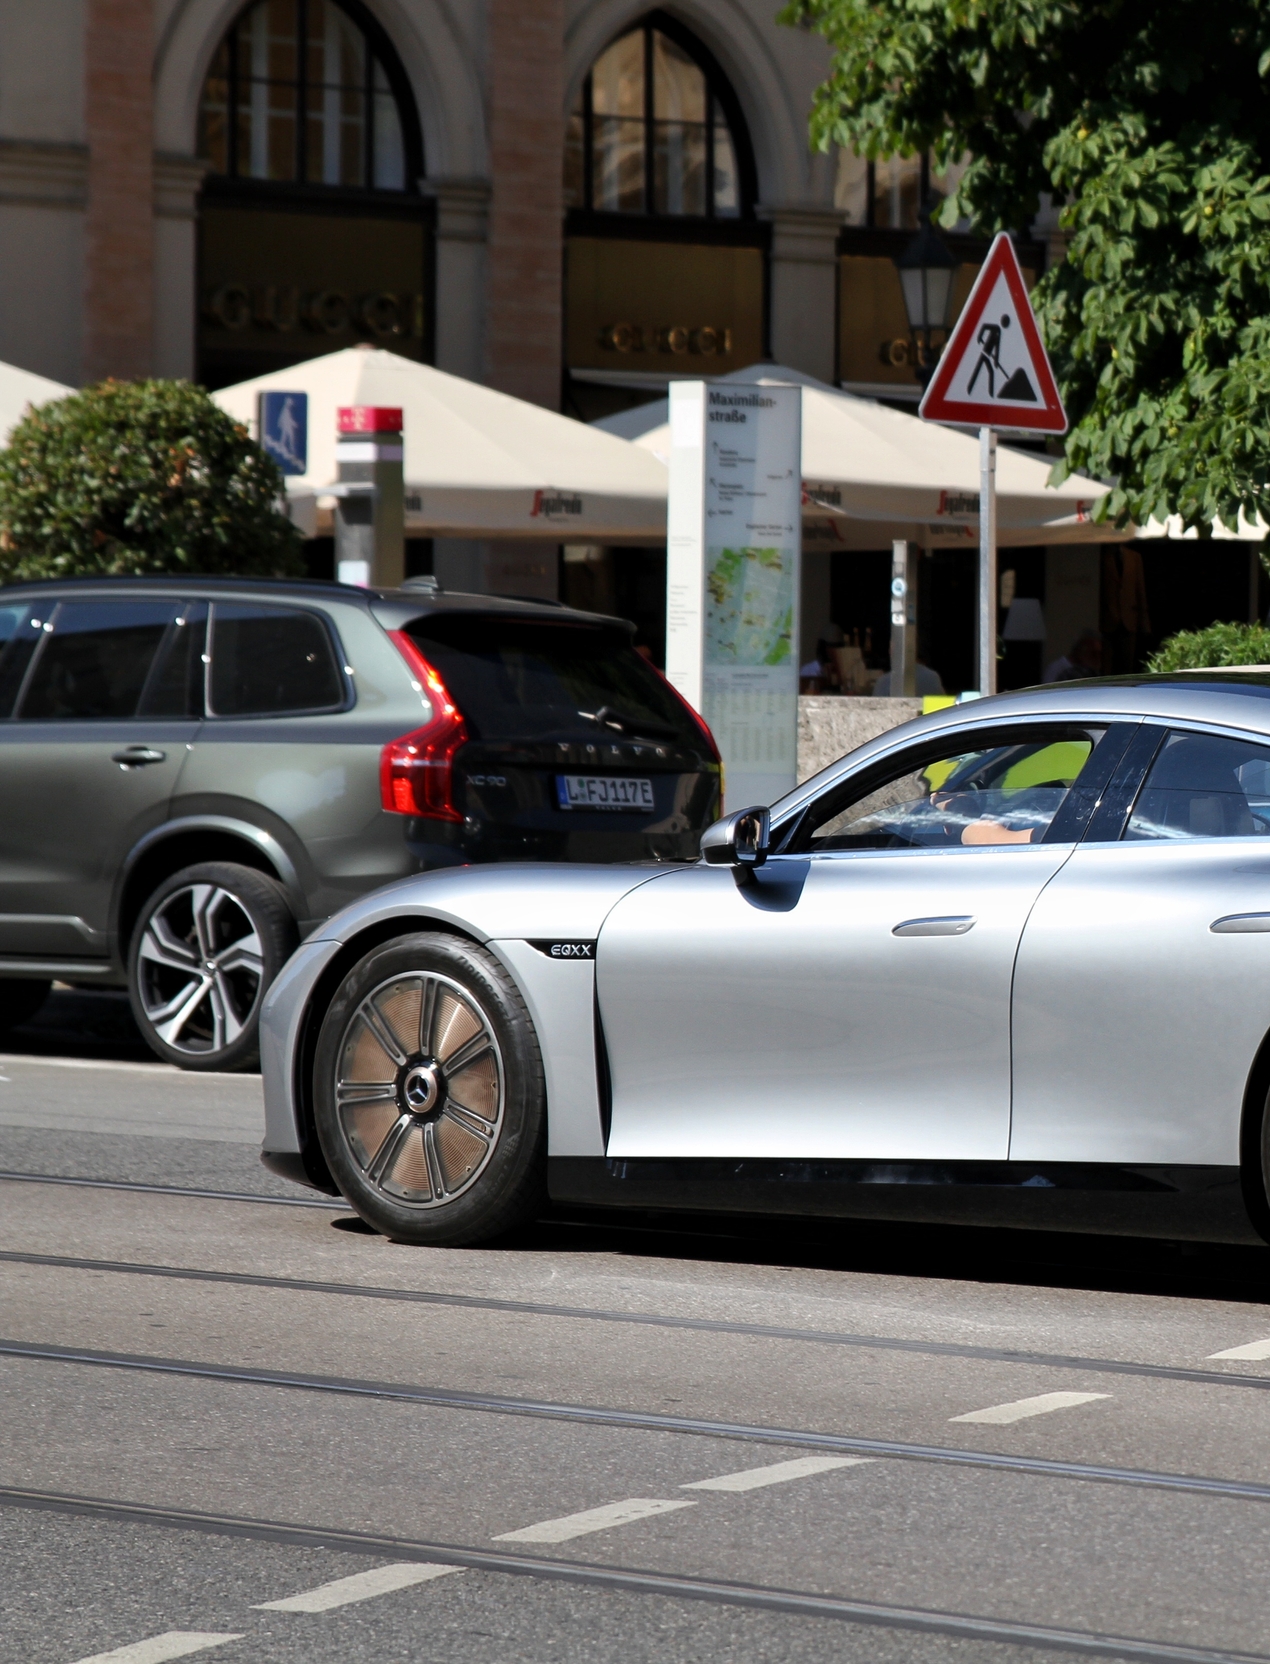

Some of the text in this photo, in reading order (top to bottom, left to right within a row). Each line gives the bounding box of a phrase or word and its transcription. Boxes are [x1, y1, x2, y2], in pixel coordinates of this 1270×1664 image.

[708, 392, 777, 408] Maximilian-
[708, 409, 747, 423] straße
[558, 742, 667, 758] VOLVO
[551, 944, 592, 956] EQXX
